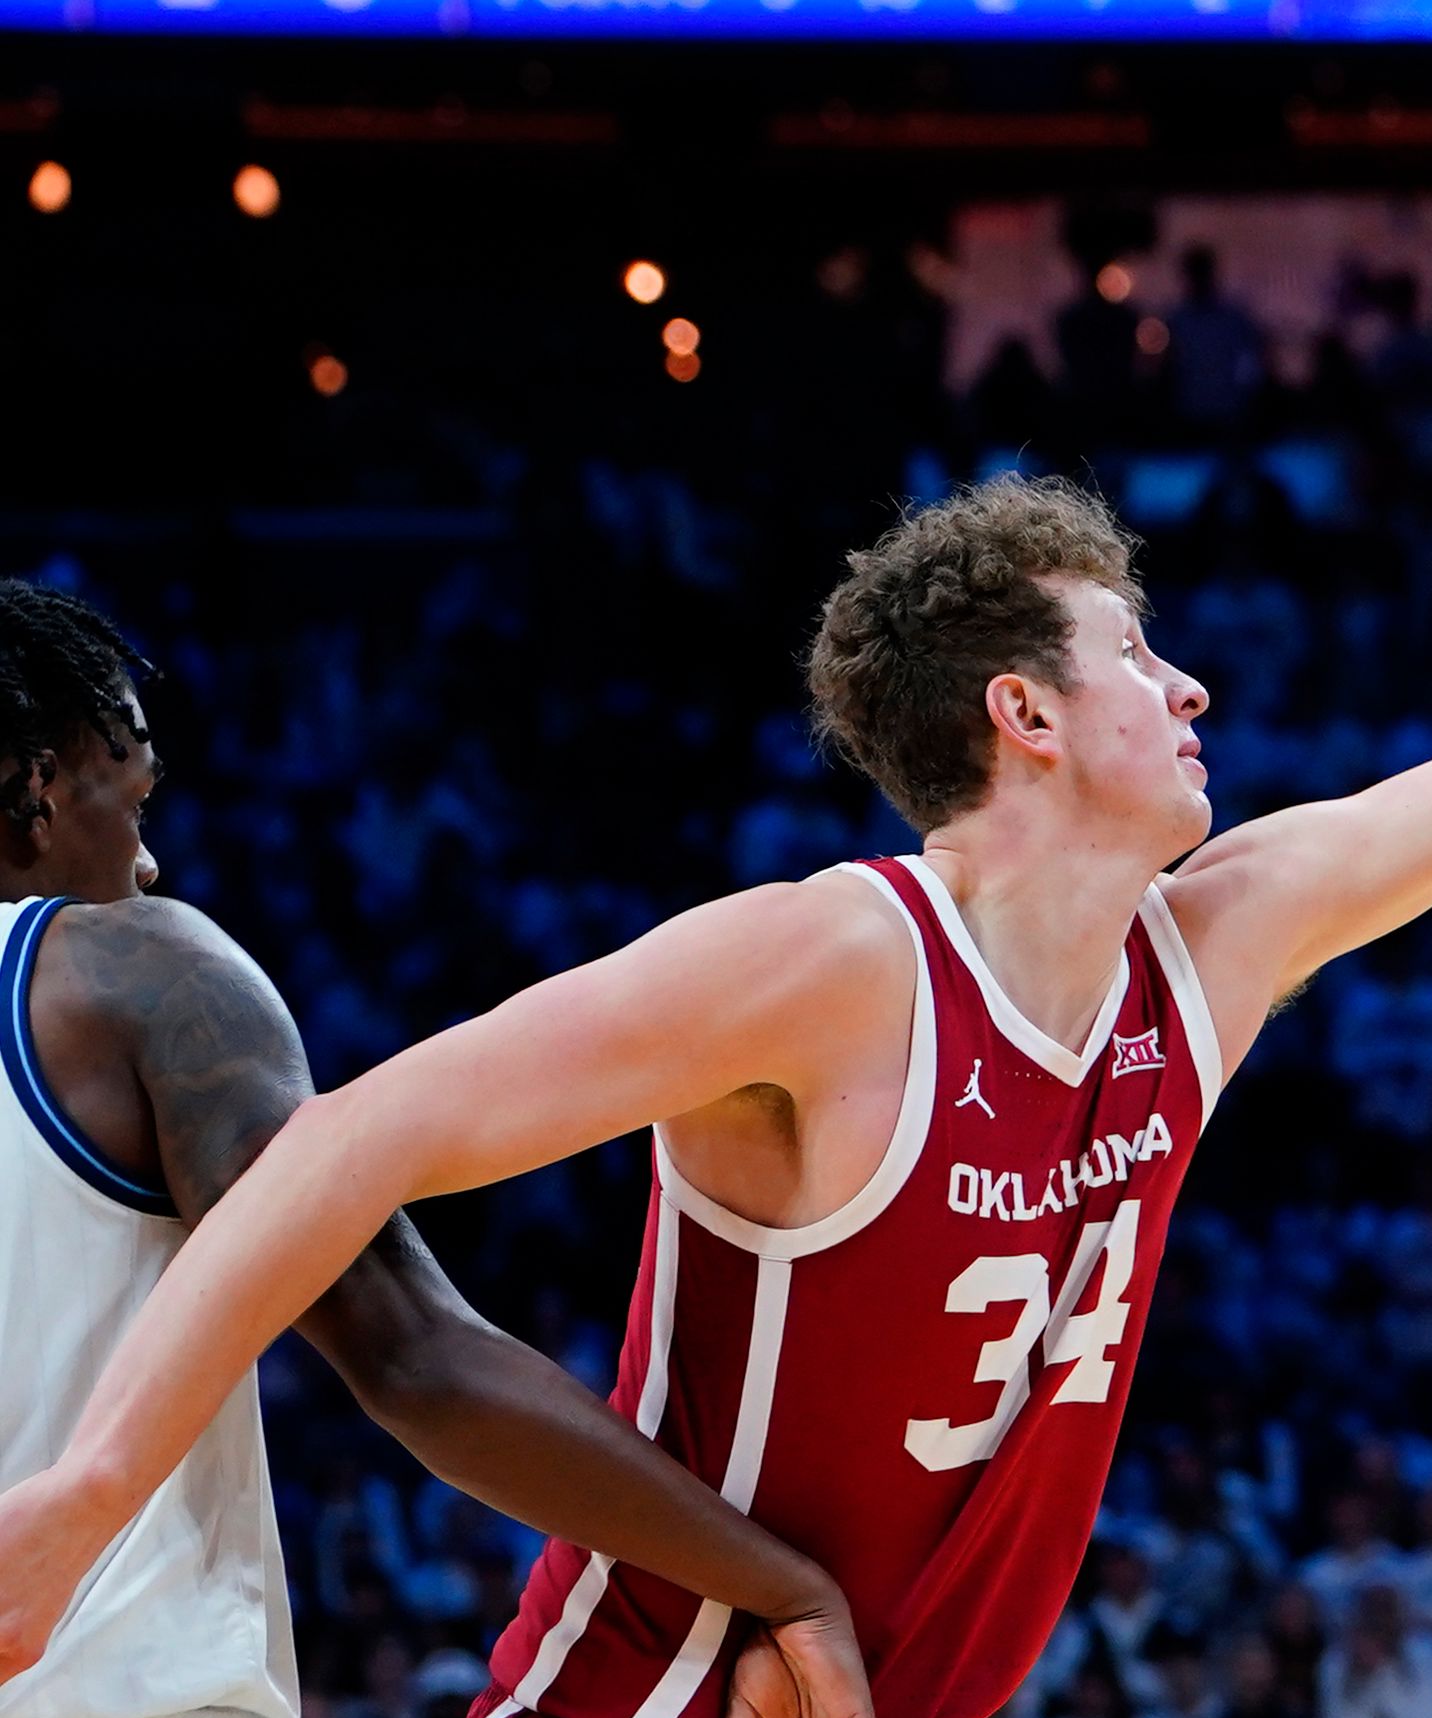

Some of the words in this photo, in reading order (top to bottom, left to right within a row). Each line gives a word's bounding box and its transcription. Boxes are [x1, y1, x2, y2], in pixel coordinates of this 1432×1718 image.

[1115, 1032, 1165, 1073] XII
[947, 1112, 1174, 1222] OKLAHOMA
[903, 1199, 1142, 1472] 34
